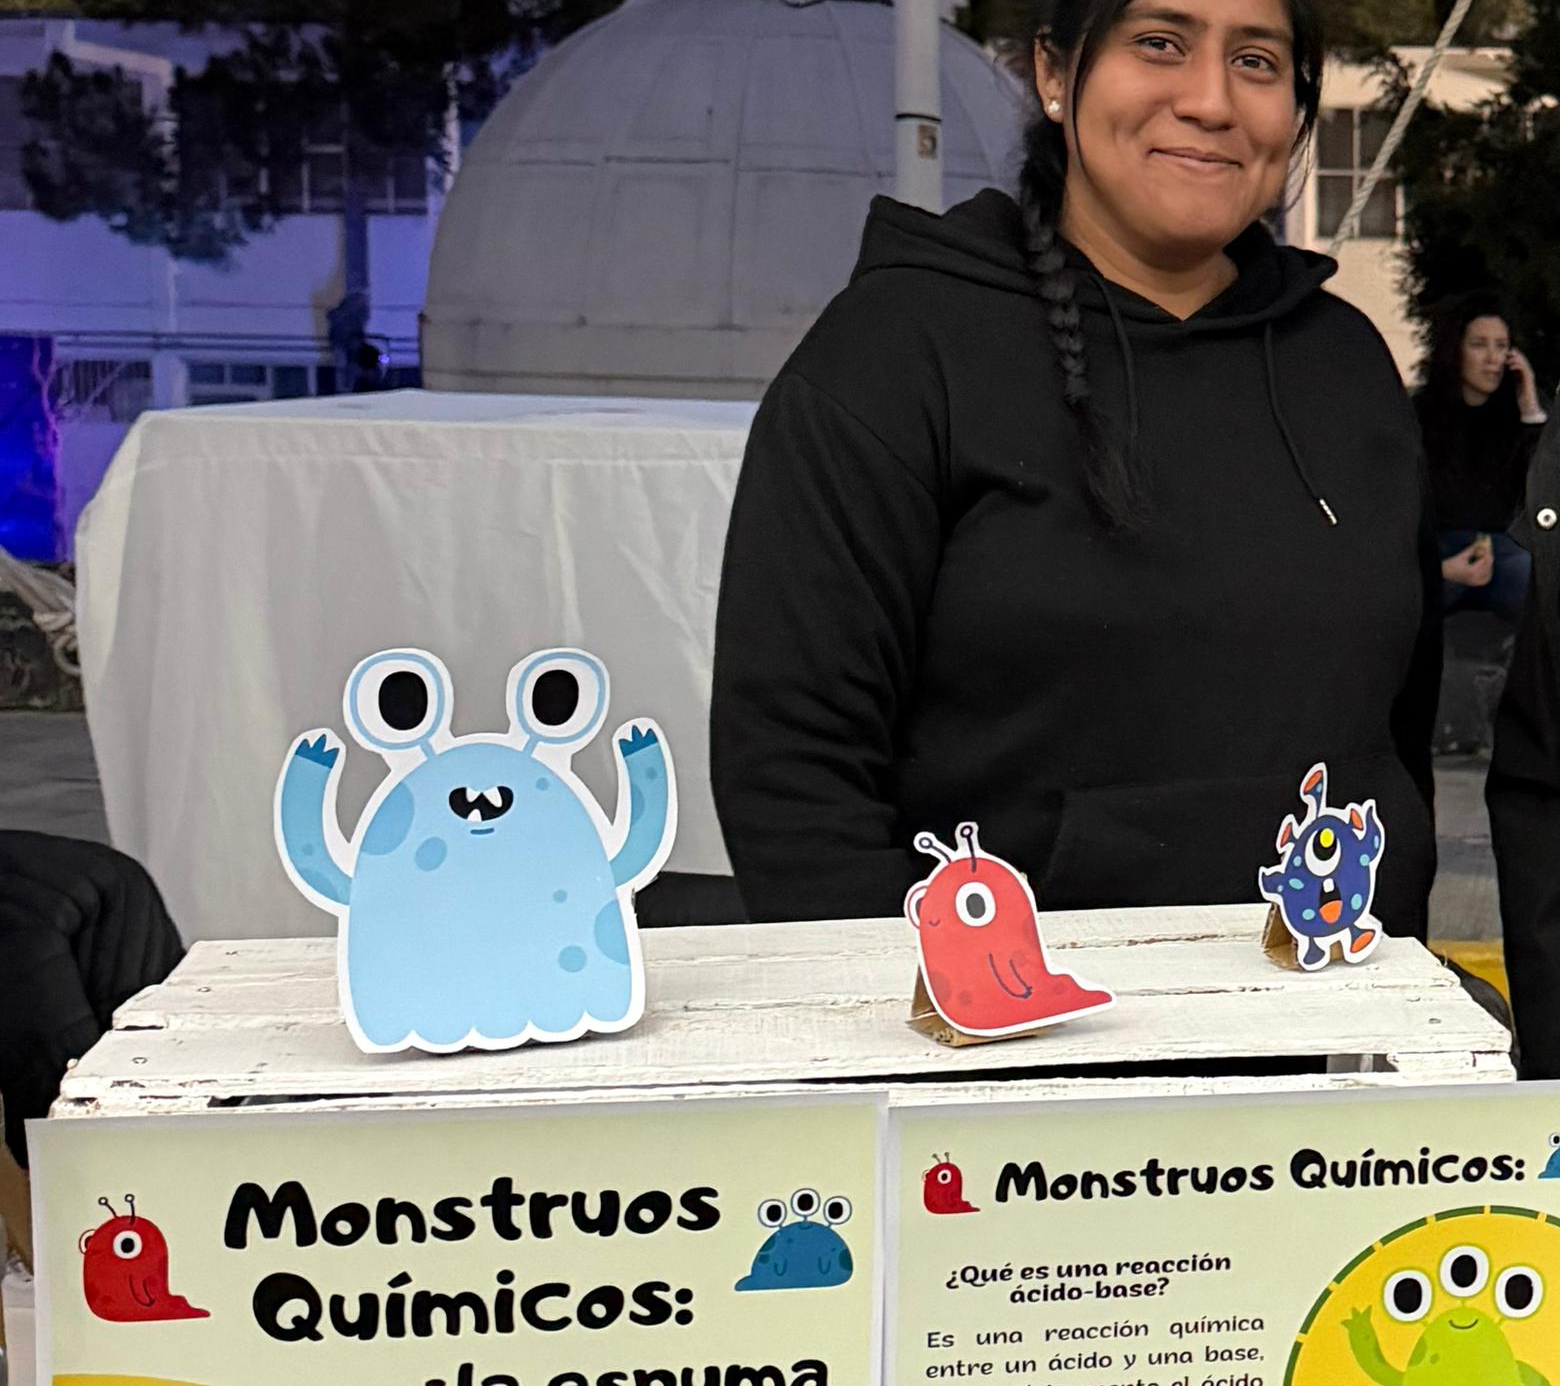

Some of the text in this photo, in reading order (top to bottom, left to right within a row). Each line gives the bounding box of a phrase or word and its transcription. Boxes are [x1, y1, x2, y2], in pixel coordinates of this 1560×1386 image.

[995, 1146, 1525, 1203] Monstruos Químicos:
[224, 1176, 720, 1249] Monstruos
[945, 1253, 1231, 1289] ¿Qué es una reacción
[253, 1269, 693, 1341] Químicos:
[1010, 1277, 1169, 1303] ácido-base?
[927, 1315, 1264, 1348] Es una reacción química
[925, 1345, 1264, 1378] entre un ácido y una base,
